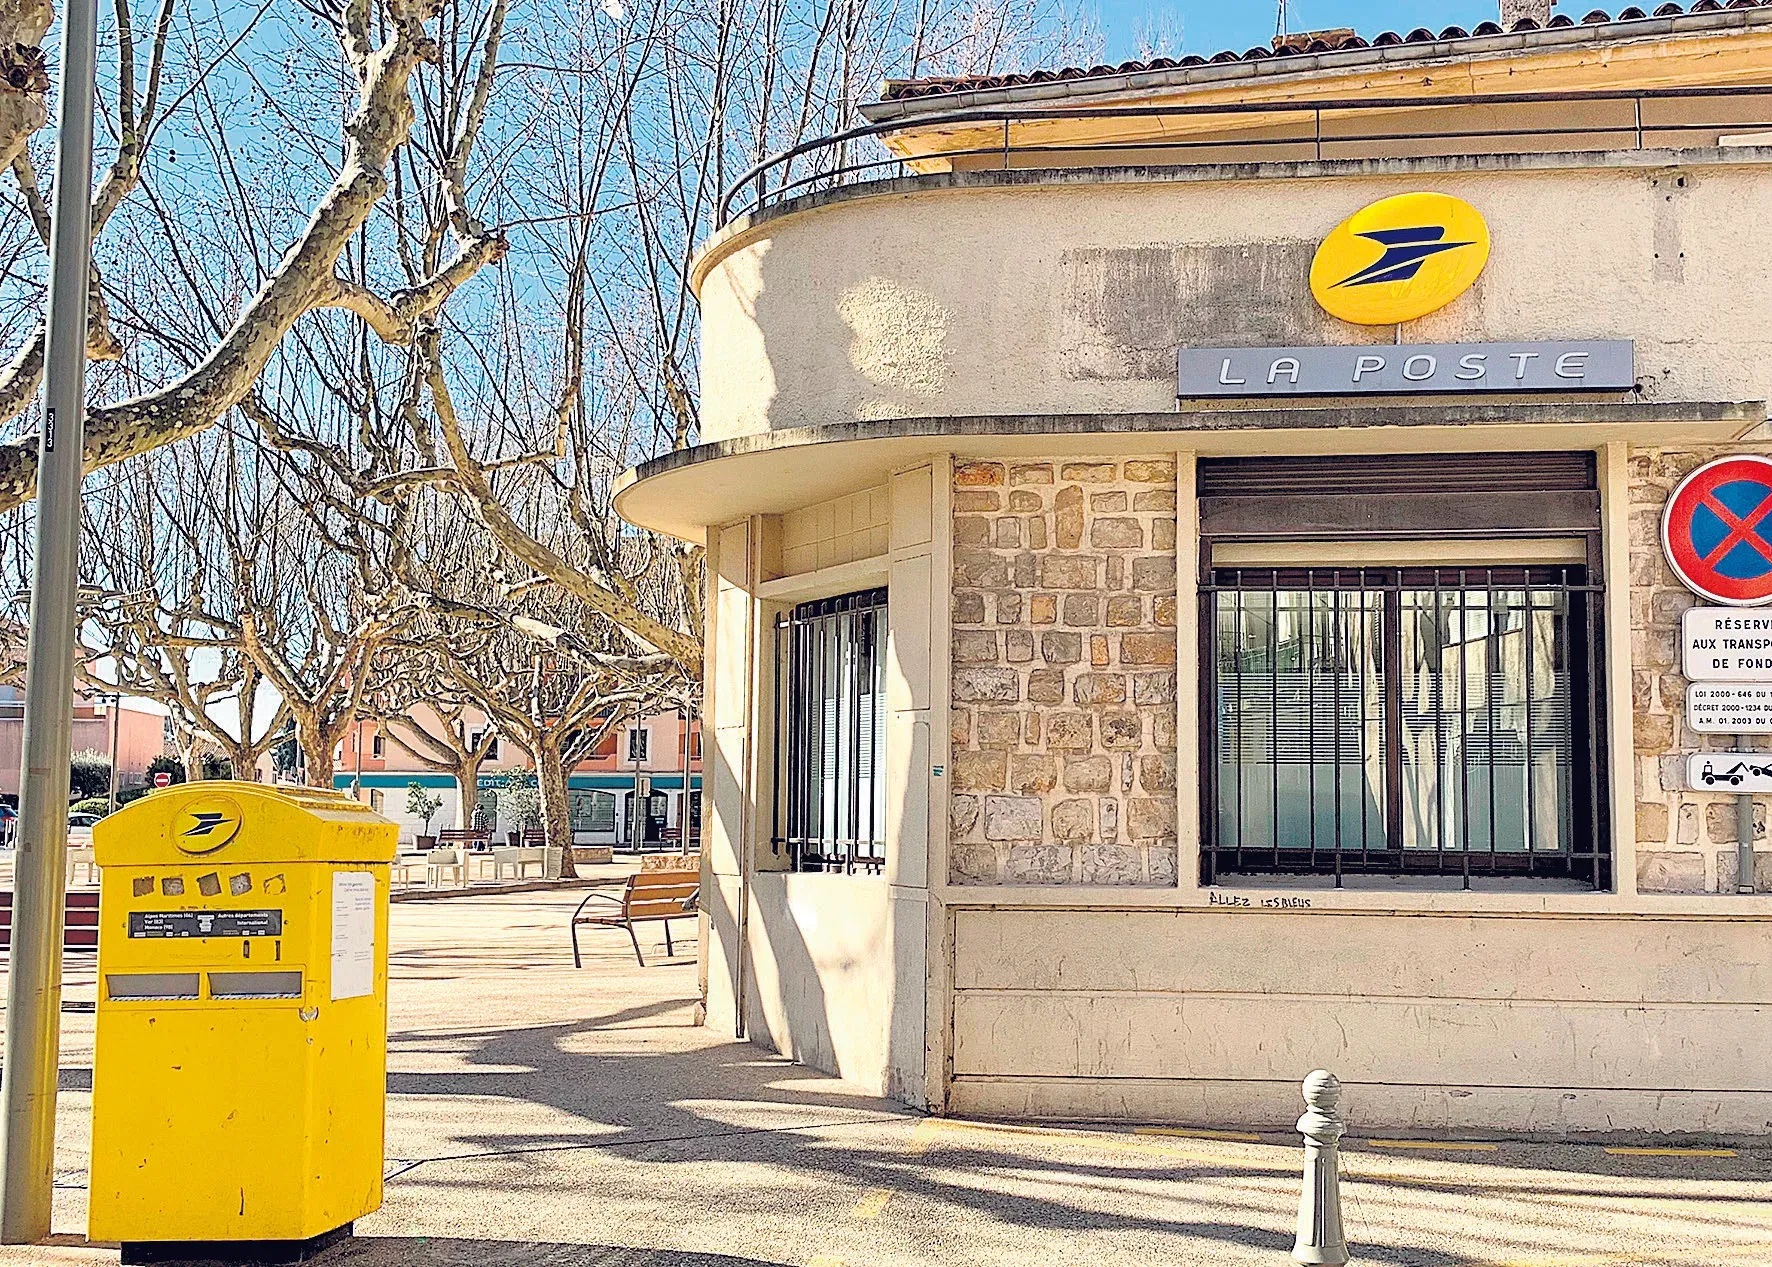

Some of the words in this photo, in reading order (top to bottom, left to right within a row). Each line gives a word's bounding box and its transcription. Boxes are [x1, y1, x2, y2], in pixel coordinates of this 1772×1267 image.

[1218, 357, 1300, 385] LA
[1351, 352, 1590, 383] POSTE
[1715, 617, 1772, 629] RÉSERV
[1692, 639, 1716, 649] AUX
[1722, 639, 1772, 649] TRANSP
[1713, 658, 1729, 668] DE
[1738, 658, 1772, 668] FOND
[1693, 703, 1719, 711] DÉCRET
[1209, 891, 1251, 907] ALLEZ
